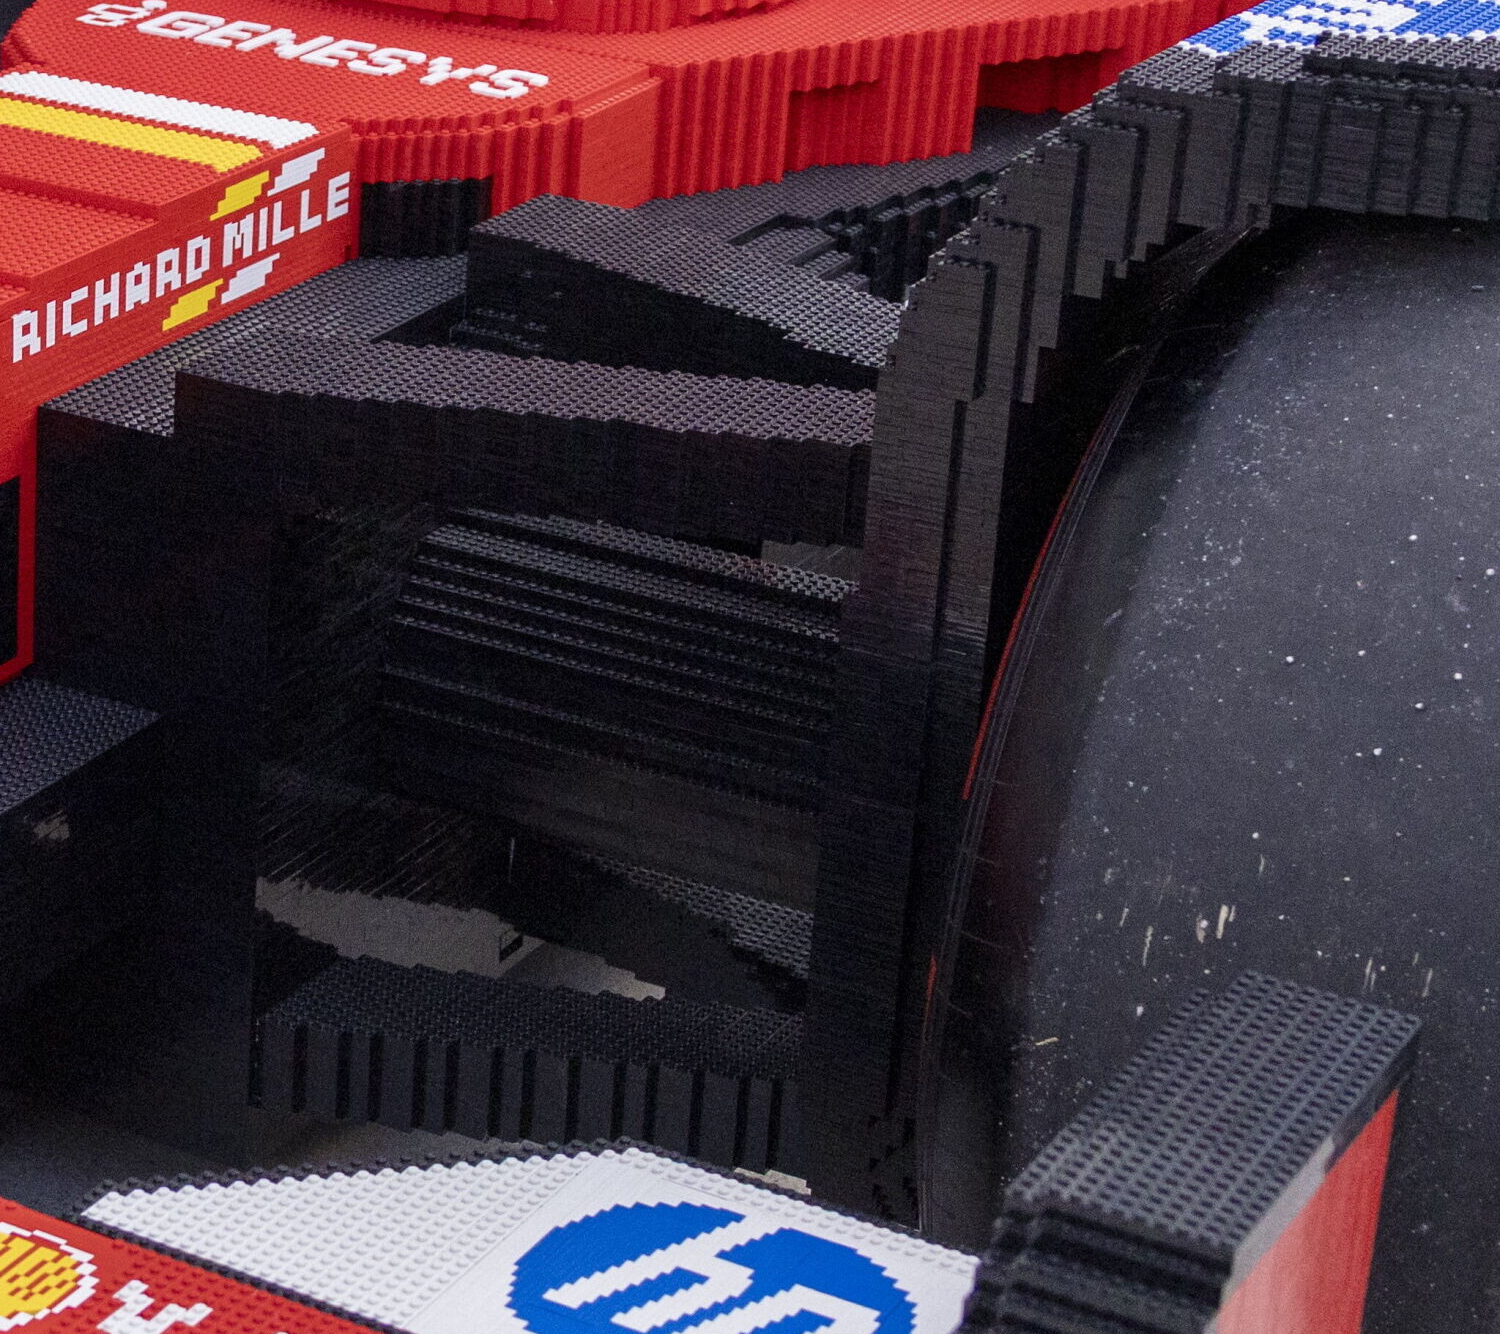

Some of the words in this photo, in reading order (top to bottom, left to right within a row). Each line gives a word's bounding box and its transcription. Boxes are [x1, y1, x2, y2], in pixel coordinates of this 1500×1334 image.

[136, 9, 552, 99] GENESYS
[11, 234, 212, 364] RICHARD
[221, 170, 352, 268] MILLE
